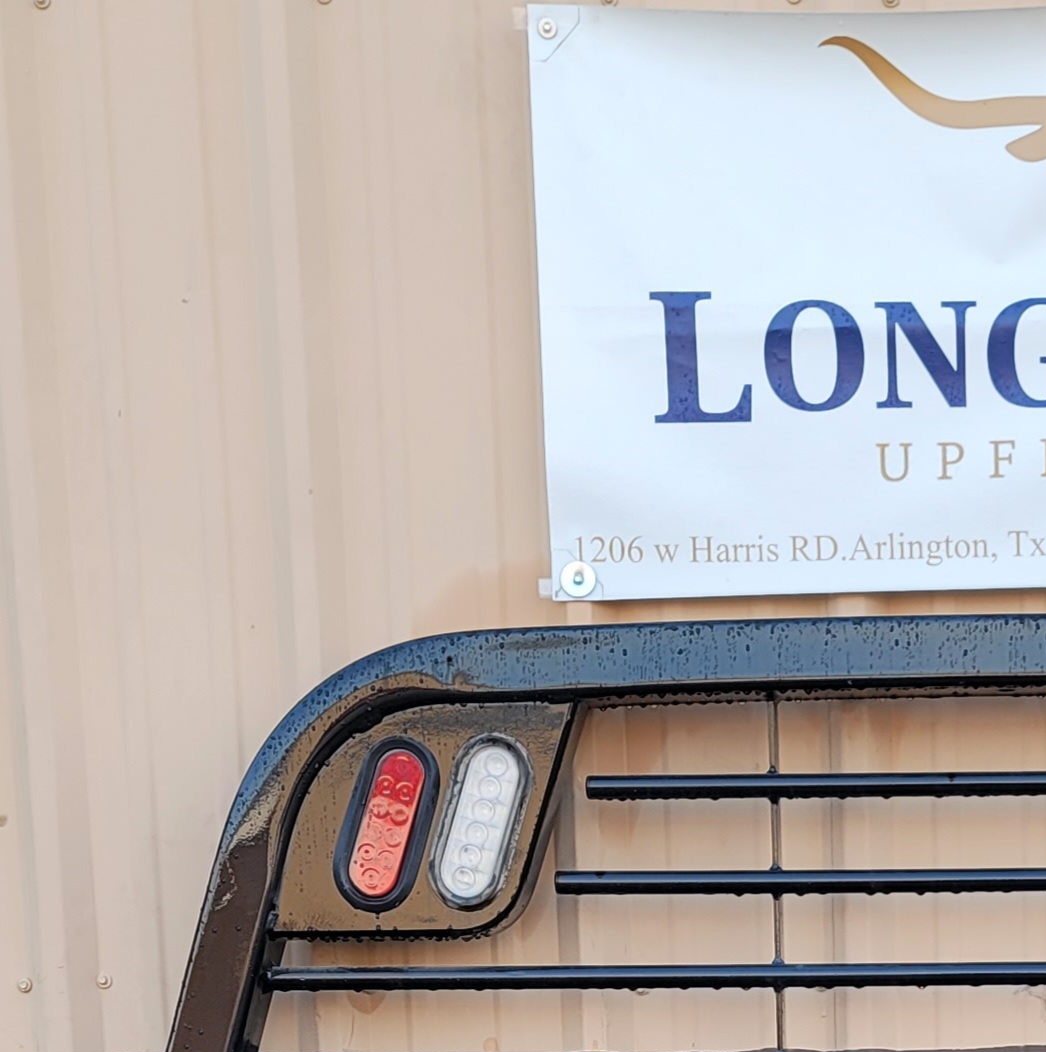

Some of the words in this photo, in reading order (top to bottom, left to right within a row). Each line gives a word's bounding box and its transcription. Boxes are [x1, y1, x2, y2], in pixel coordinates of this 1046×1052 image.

[574, 534, 644, 564] 1206
[653, 542, 680, 563] w
[689, 533, 780, 563] Harris
